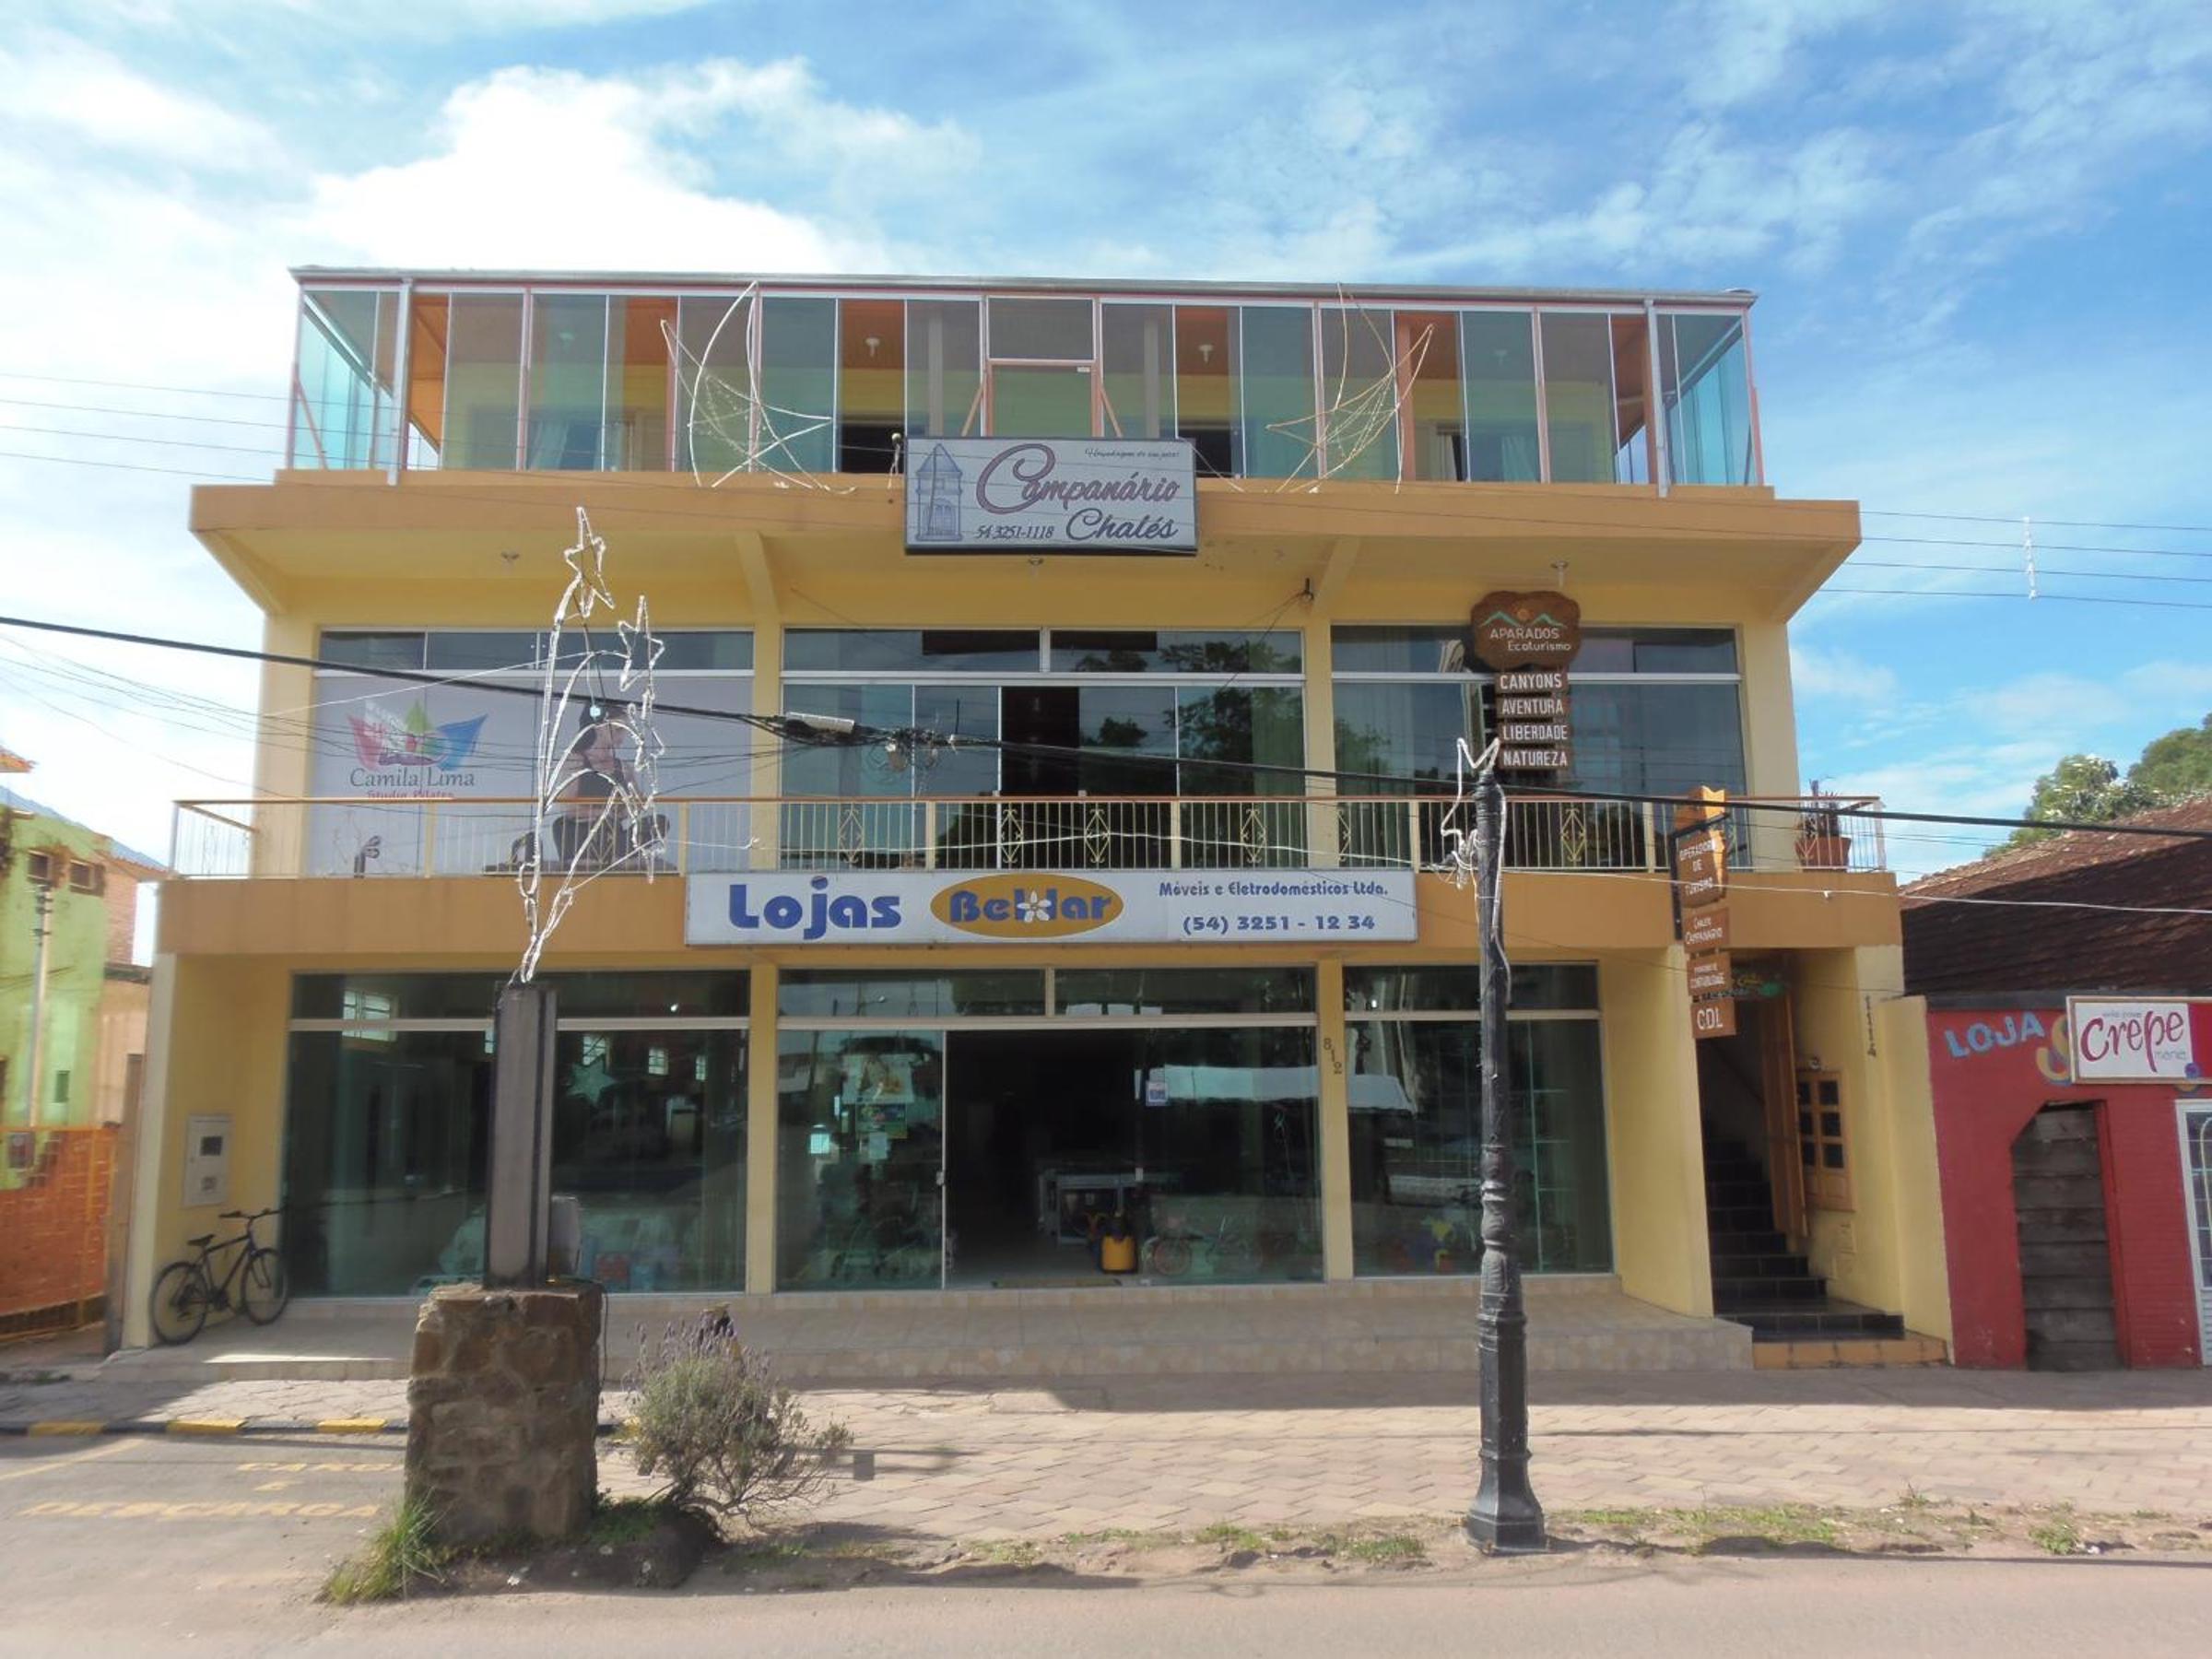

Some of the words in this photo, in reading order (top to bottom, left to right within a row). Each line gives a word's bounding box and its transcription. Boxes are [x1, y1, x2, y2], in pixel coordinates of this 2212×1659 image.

[976, 442, 1180, 514] Campanário
[1065, 508, 1179, 541] Chalés
[1488, 628, 1560, 640] APARADOS
[1507, 641, 1571, 651] Ecoturismo
[1499, 674, 1563, 690] CANYONS
[1501, 698, 1564, 714] AVENTURA
[1502, 724, 1568, 741] LIBERDADE
[1503, 750, 1568, 767] NATUREZA
[350, 767, 419, 787] Camila
[428, 766, 476, 787] Lima
[1693, 858, 1702, 872] DE
[1159, 881, 1209, 897] Móveis
[1215, 885, 1224, 896] e
[1353, 881, 1388, 896] Ltda.
[729, 876, 901, 940] Lojas
[1183, 915, 1230, 935] (54)
[1237, 916, 1289, 931] 3251
[1697, 1007, 1724, 1030] CDL
[1944, 1011, 2045, 1058] LOJA
[2080, 1010, 2184, 1073] Crepe
